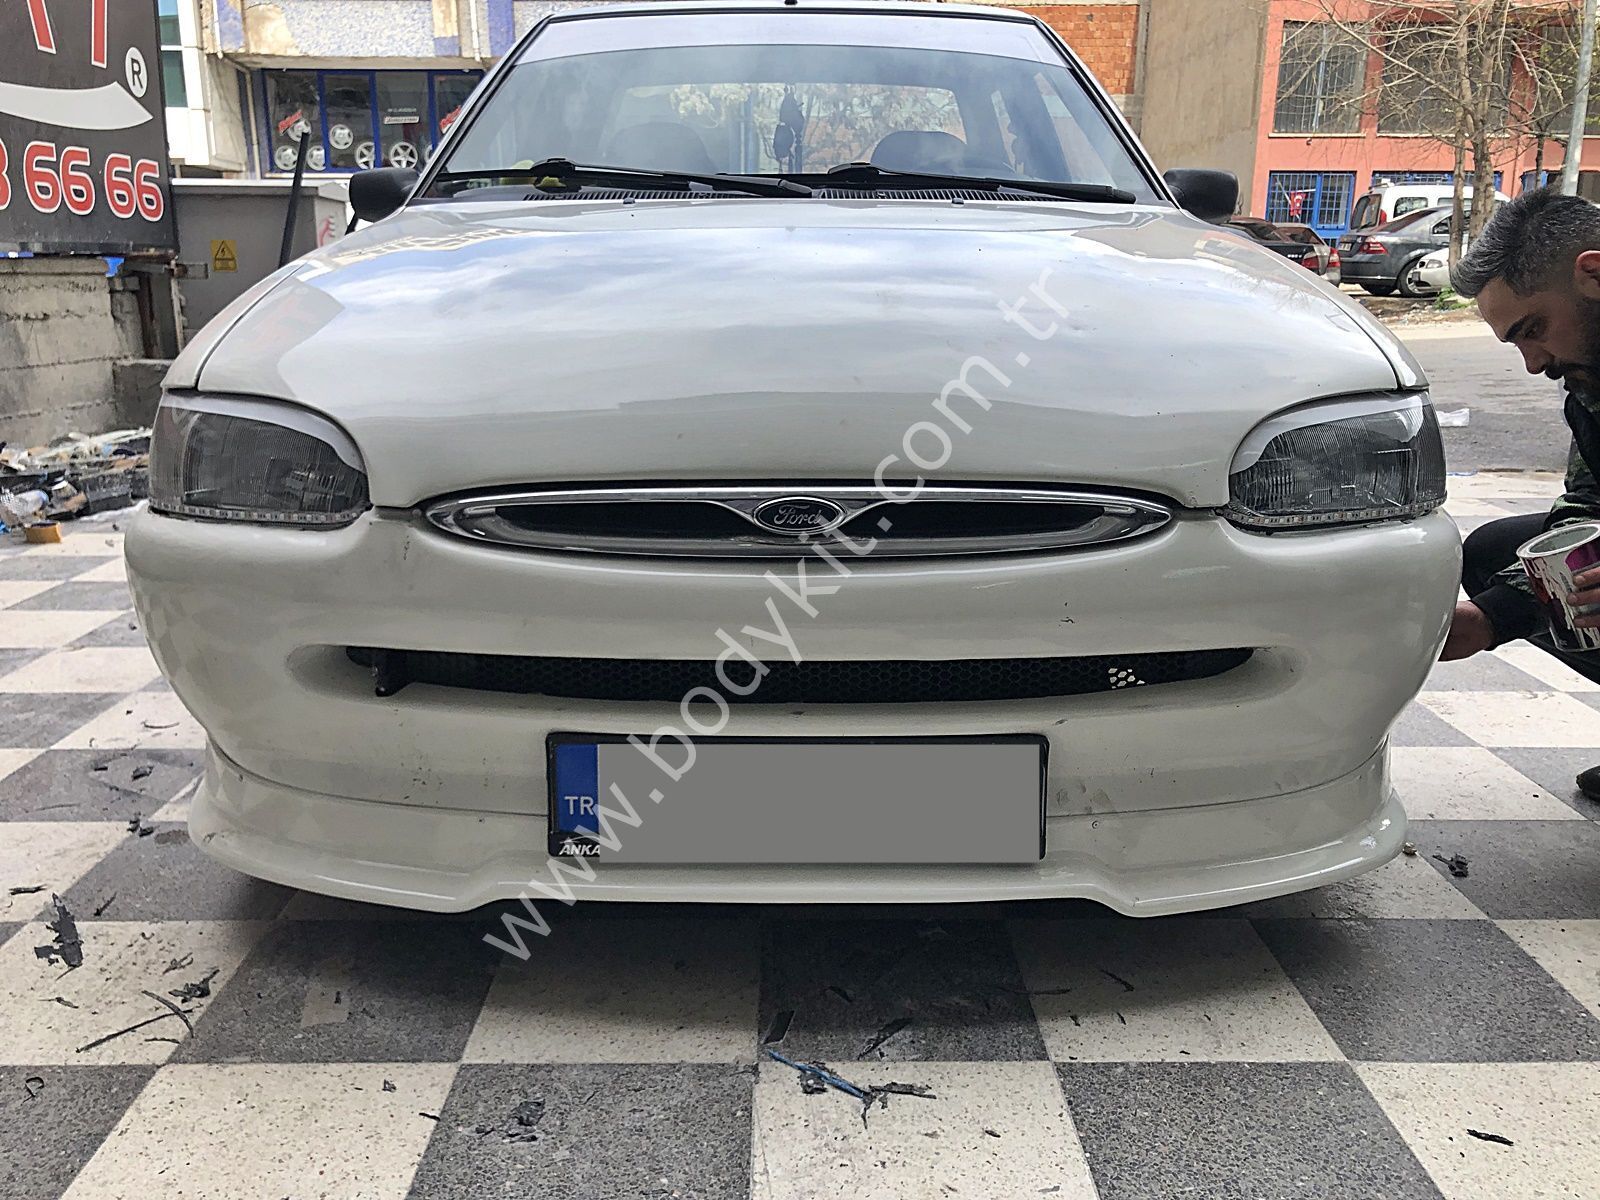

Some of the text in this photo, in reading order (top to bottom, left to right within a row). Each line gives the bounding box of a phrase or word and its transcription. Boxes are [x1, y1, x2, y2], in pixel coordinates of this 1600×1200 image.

[24, 140, 96, 216] 66
[104, 152, 164, 222] 66
[773, 504, 822, 525] Ford
[564, 796, 594, 815] TR
